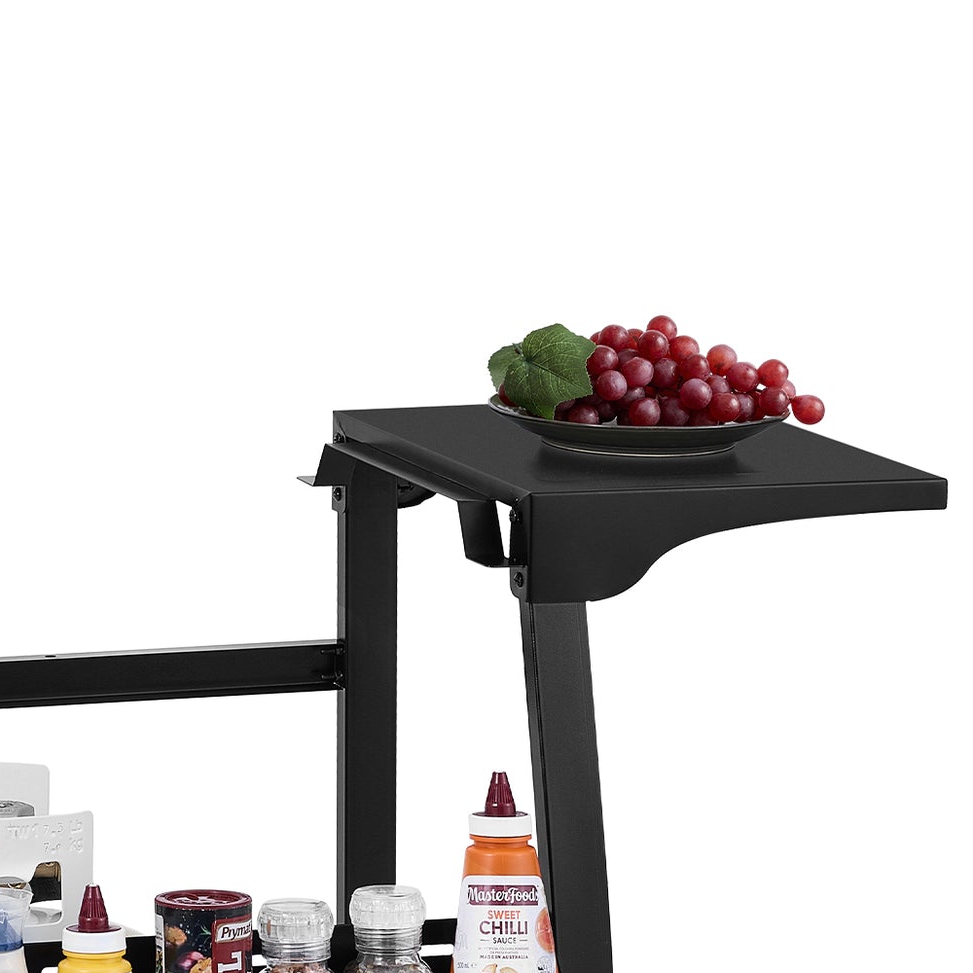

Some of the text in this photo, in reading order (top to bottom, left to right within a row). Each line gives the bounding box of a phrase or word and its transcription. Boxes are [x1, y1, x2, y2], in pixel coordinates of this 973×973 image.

[467, 887, 539, 903] MasterFoods
[487, 910, 521, 920] SWEET
[479, 921, 528, 935] CHILLI
[492, 937, 517, 945] SAUCE
